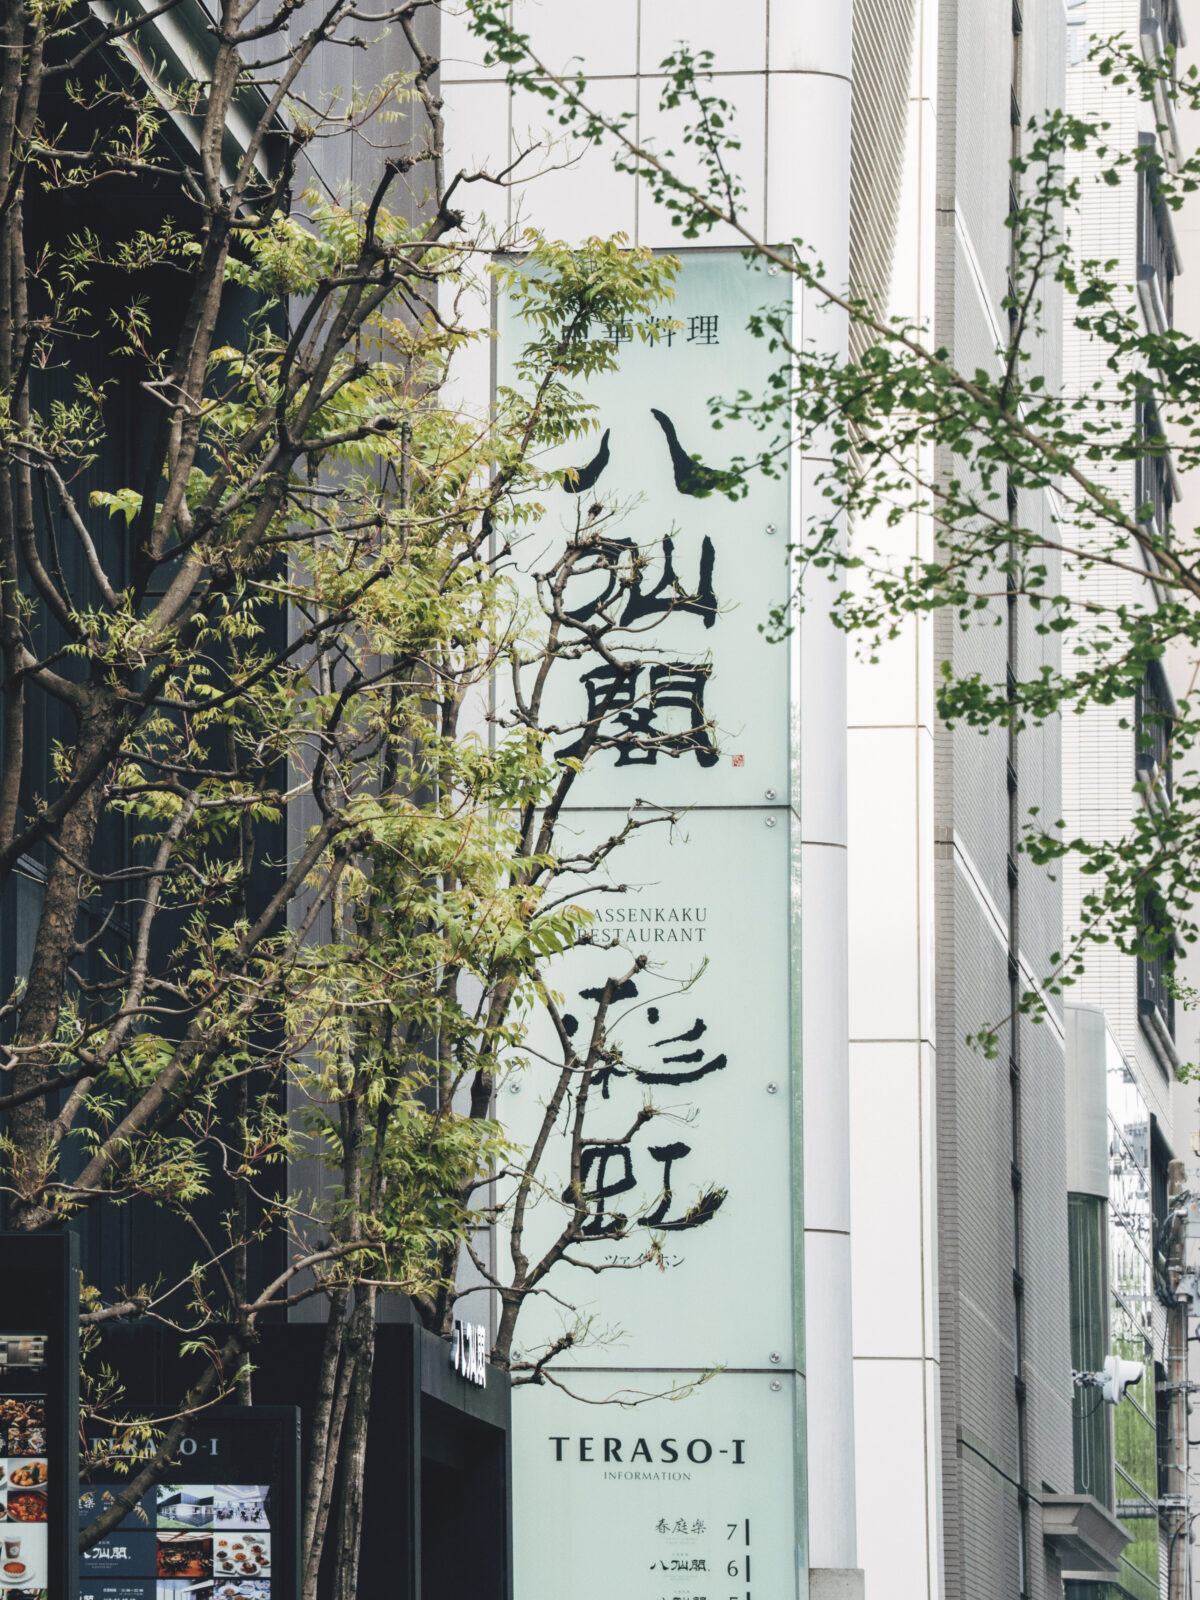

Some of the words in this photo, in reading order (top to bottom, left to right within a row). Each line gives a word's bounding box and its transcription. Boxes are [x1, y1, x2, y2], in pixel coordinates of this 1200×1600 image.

[581, 907, 707, 922] ASSENKAKU
[88, 1437, 219, 1456] TERAO-I
[548, 1437, 746, 1464] TERASO-I
[603, 1471, 692, 1481] INFORMATION
[726, 1523, 737, 1540] 7
[727, 1560, 739, 1577] 6
